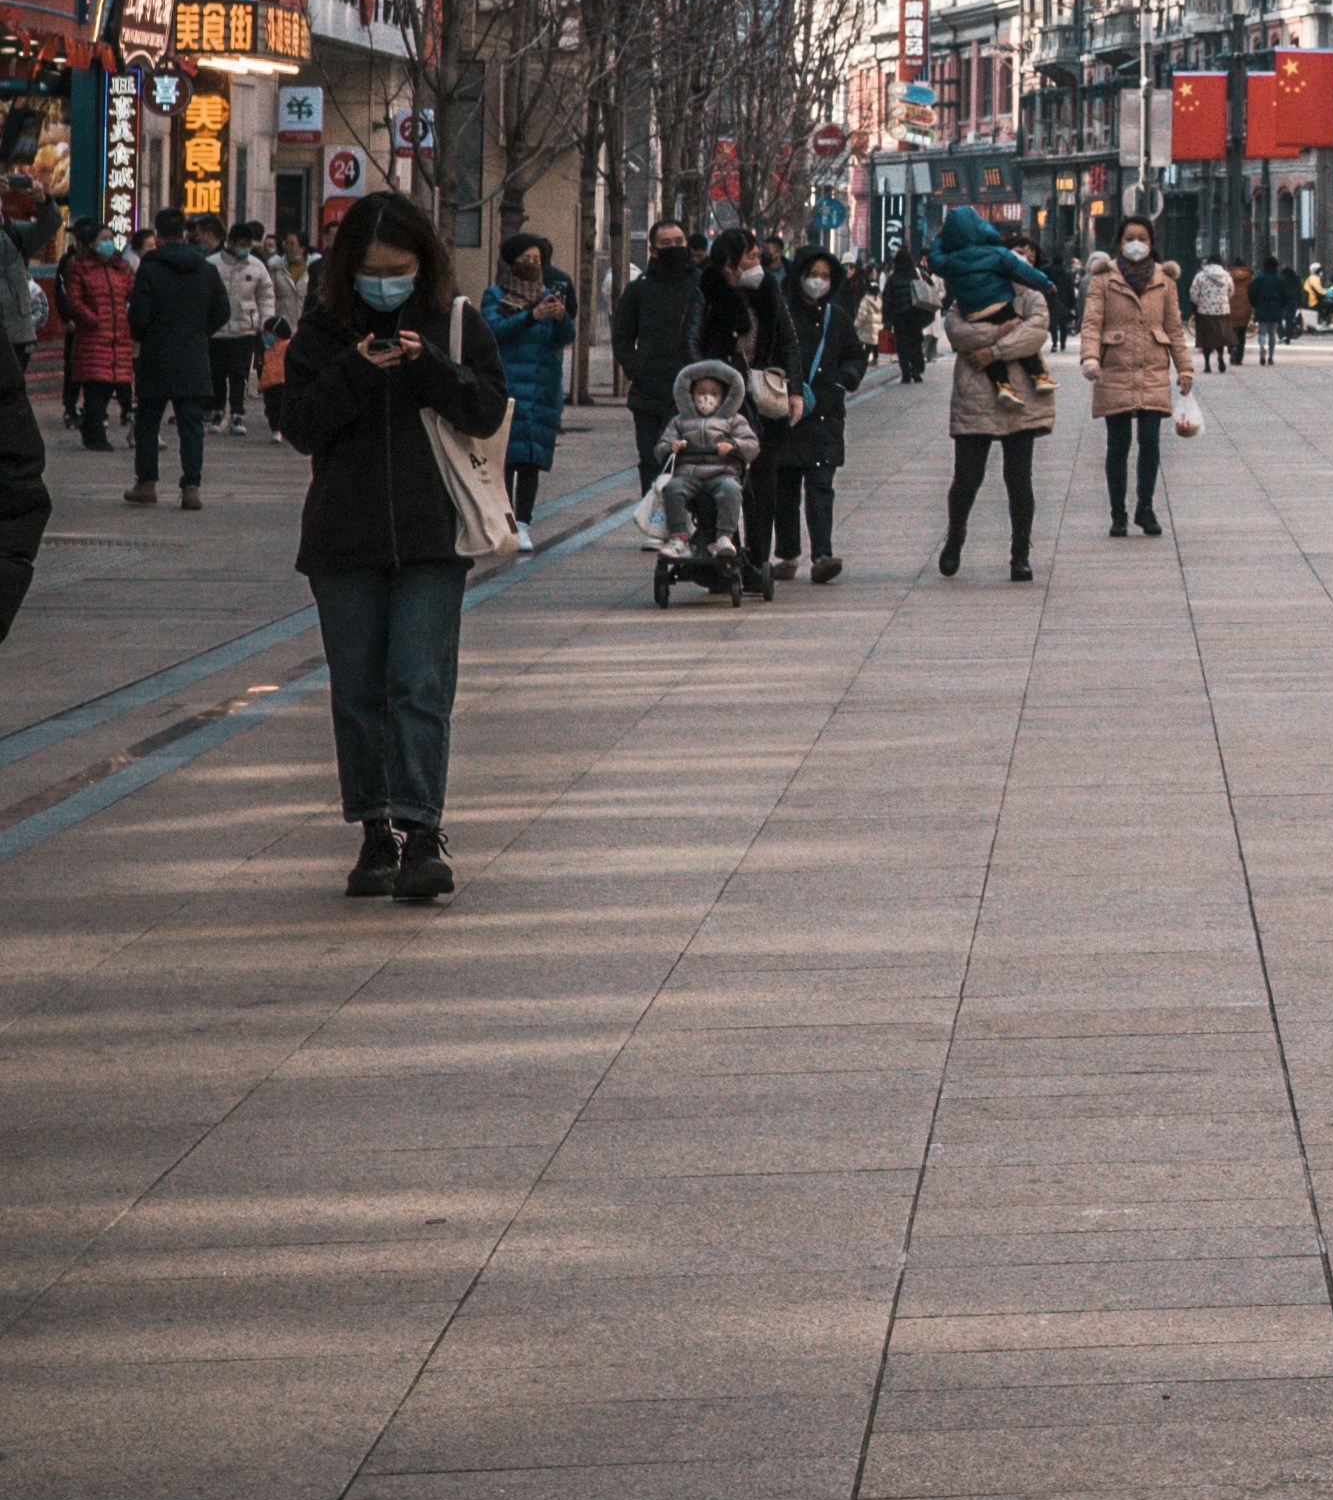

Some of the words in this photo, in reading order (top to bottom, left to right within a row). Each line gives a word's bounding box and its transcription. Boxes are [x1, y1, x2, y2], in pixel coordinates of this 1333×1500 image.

[176, 2, 253, 51] 美食街
[184, 93, 223, 215] 美食城
[334, 159, 356, 181] 24
